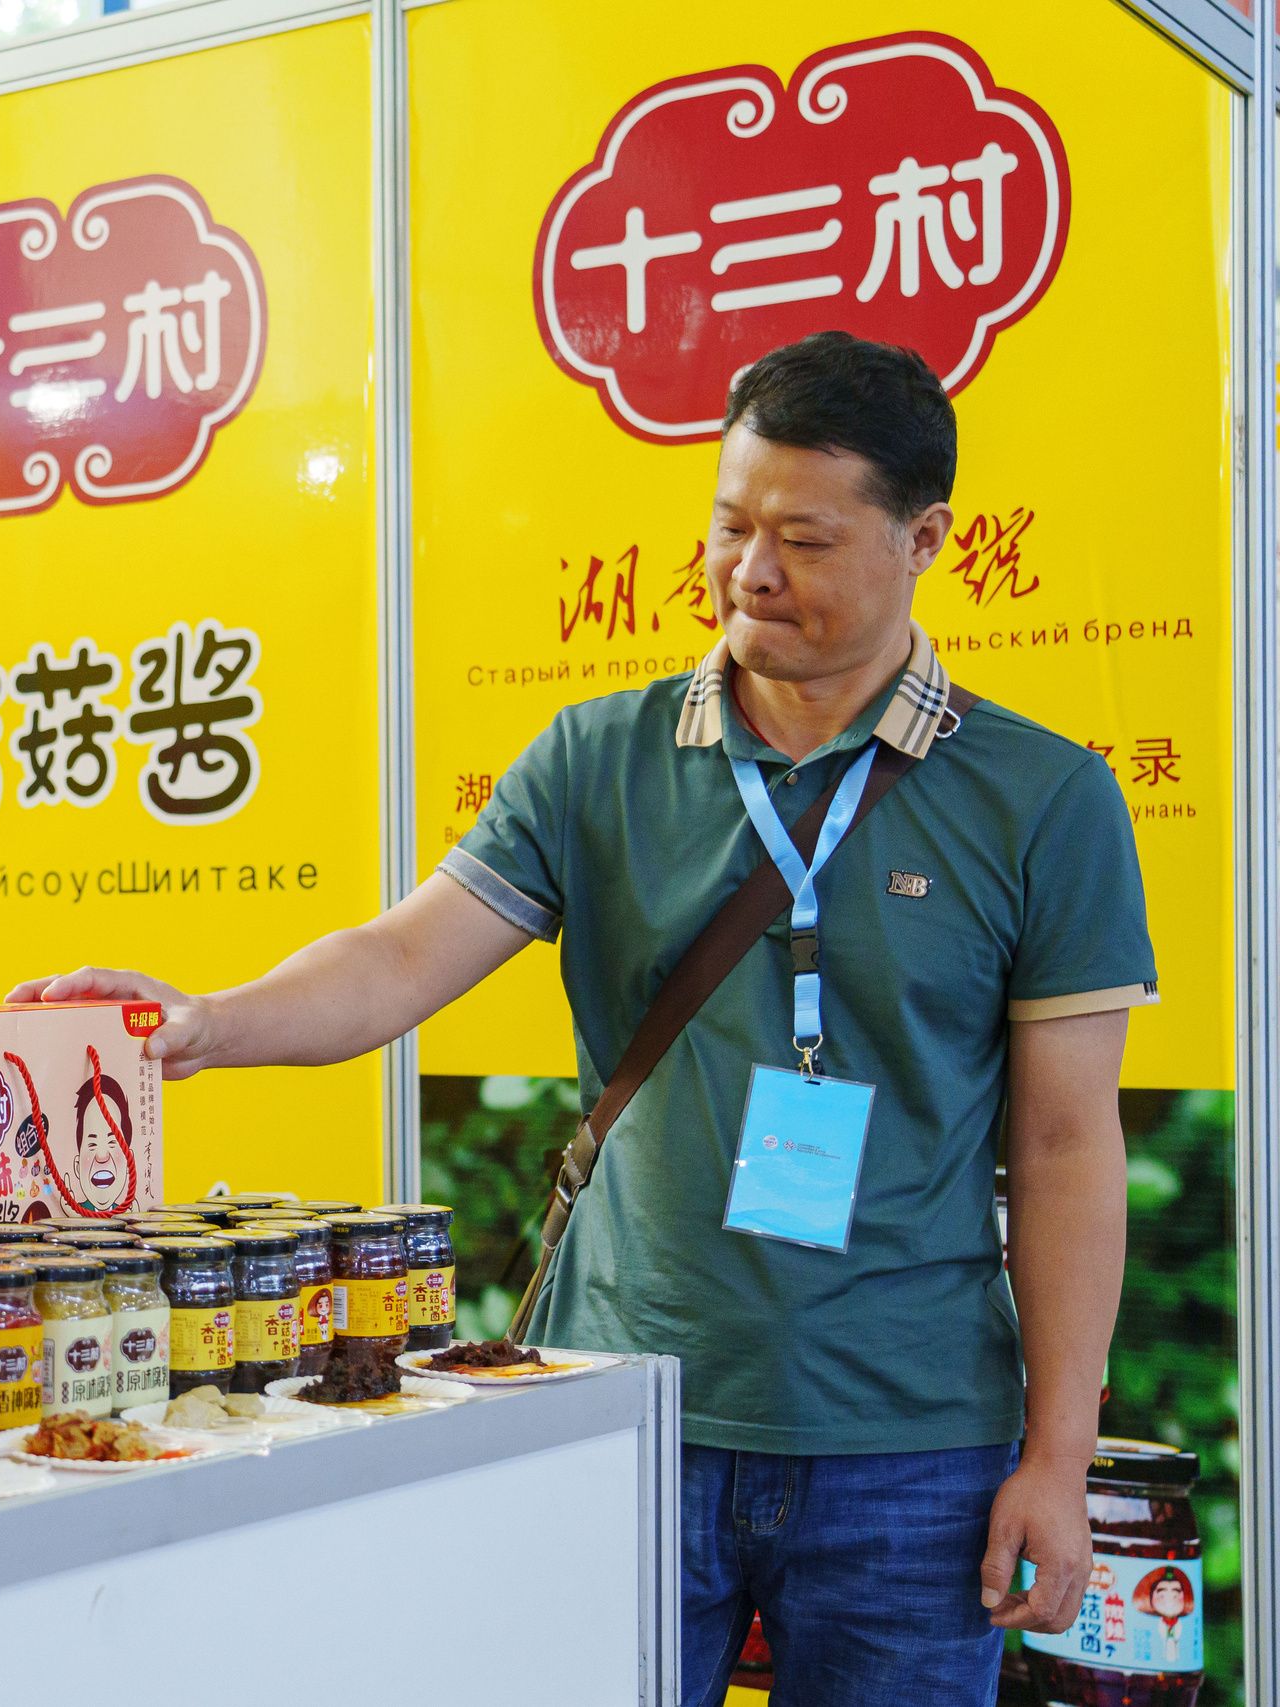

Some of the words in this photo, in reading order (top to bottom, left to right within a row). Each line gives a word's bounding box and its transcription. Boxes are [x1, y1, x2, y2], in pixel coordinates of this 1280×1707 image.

[570, 142, 1020, 334] 十三村
[467, 661, 571, 689] Старый
[582, 663, 595, 679] и
[1083, 617, 1194, 646] бренд
[1127, 801, 1197, 825] унань
[129, 1011, 159, 1028] 升级版
[16, 1112, 47, 1157] 组合
[68, 1346, 100, 1364] 十三村
[124, 1337, 156, 1353] 十三村
[126, 1365, 170, 1392] 原味腐乳
